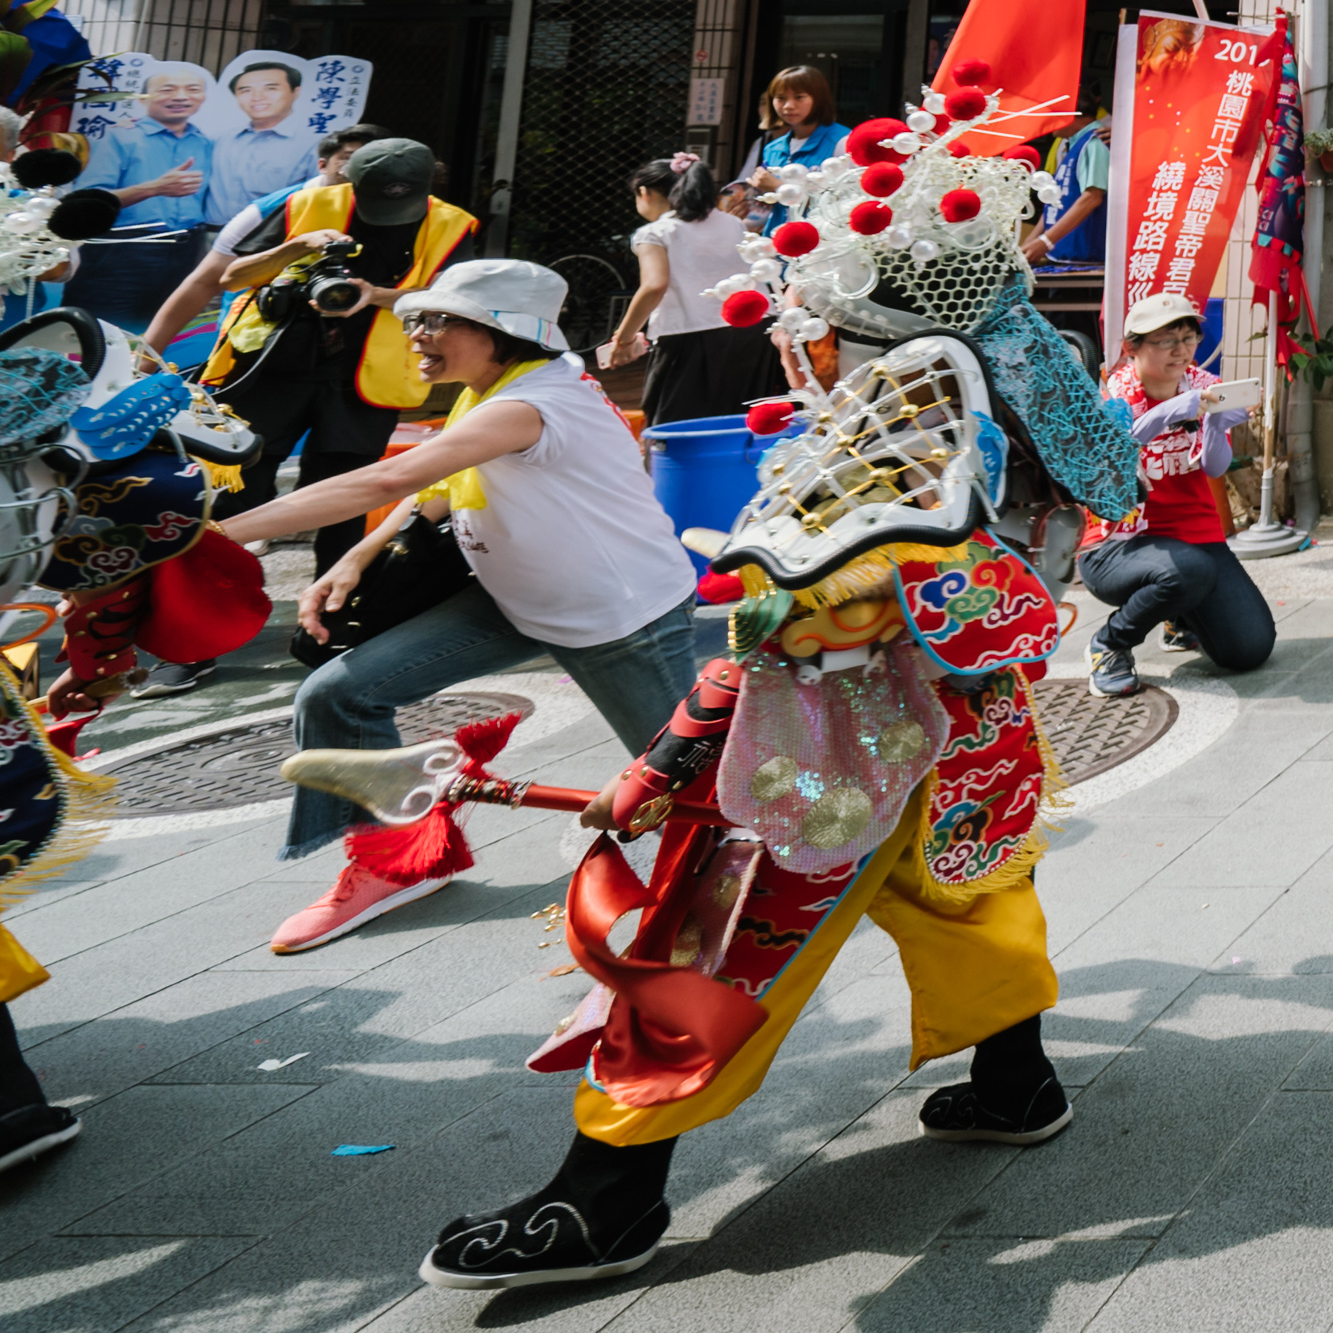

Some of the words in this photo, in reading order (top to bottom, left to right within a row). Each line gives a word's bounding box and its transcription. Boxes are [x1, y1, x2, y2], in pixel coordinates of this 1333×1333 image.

[1213, 39, 1270, 68] 201
[308, 60, 347, 134] 陳學聖
